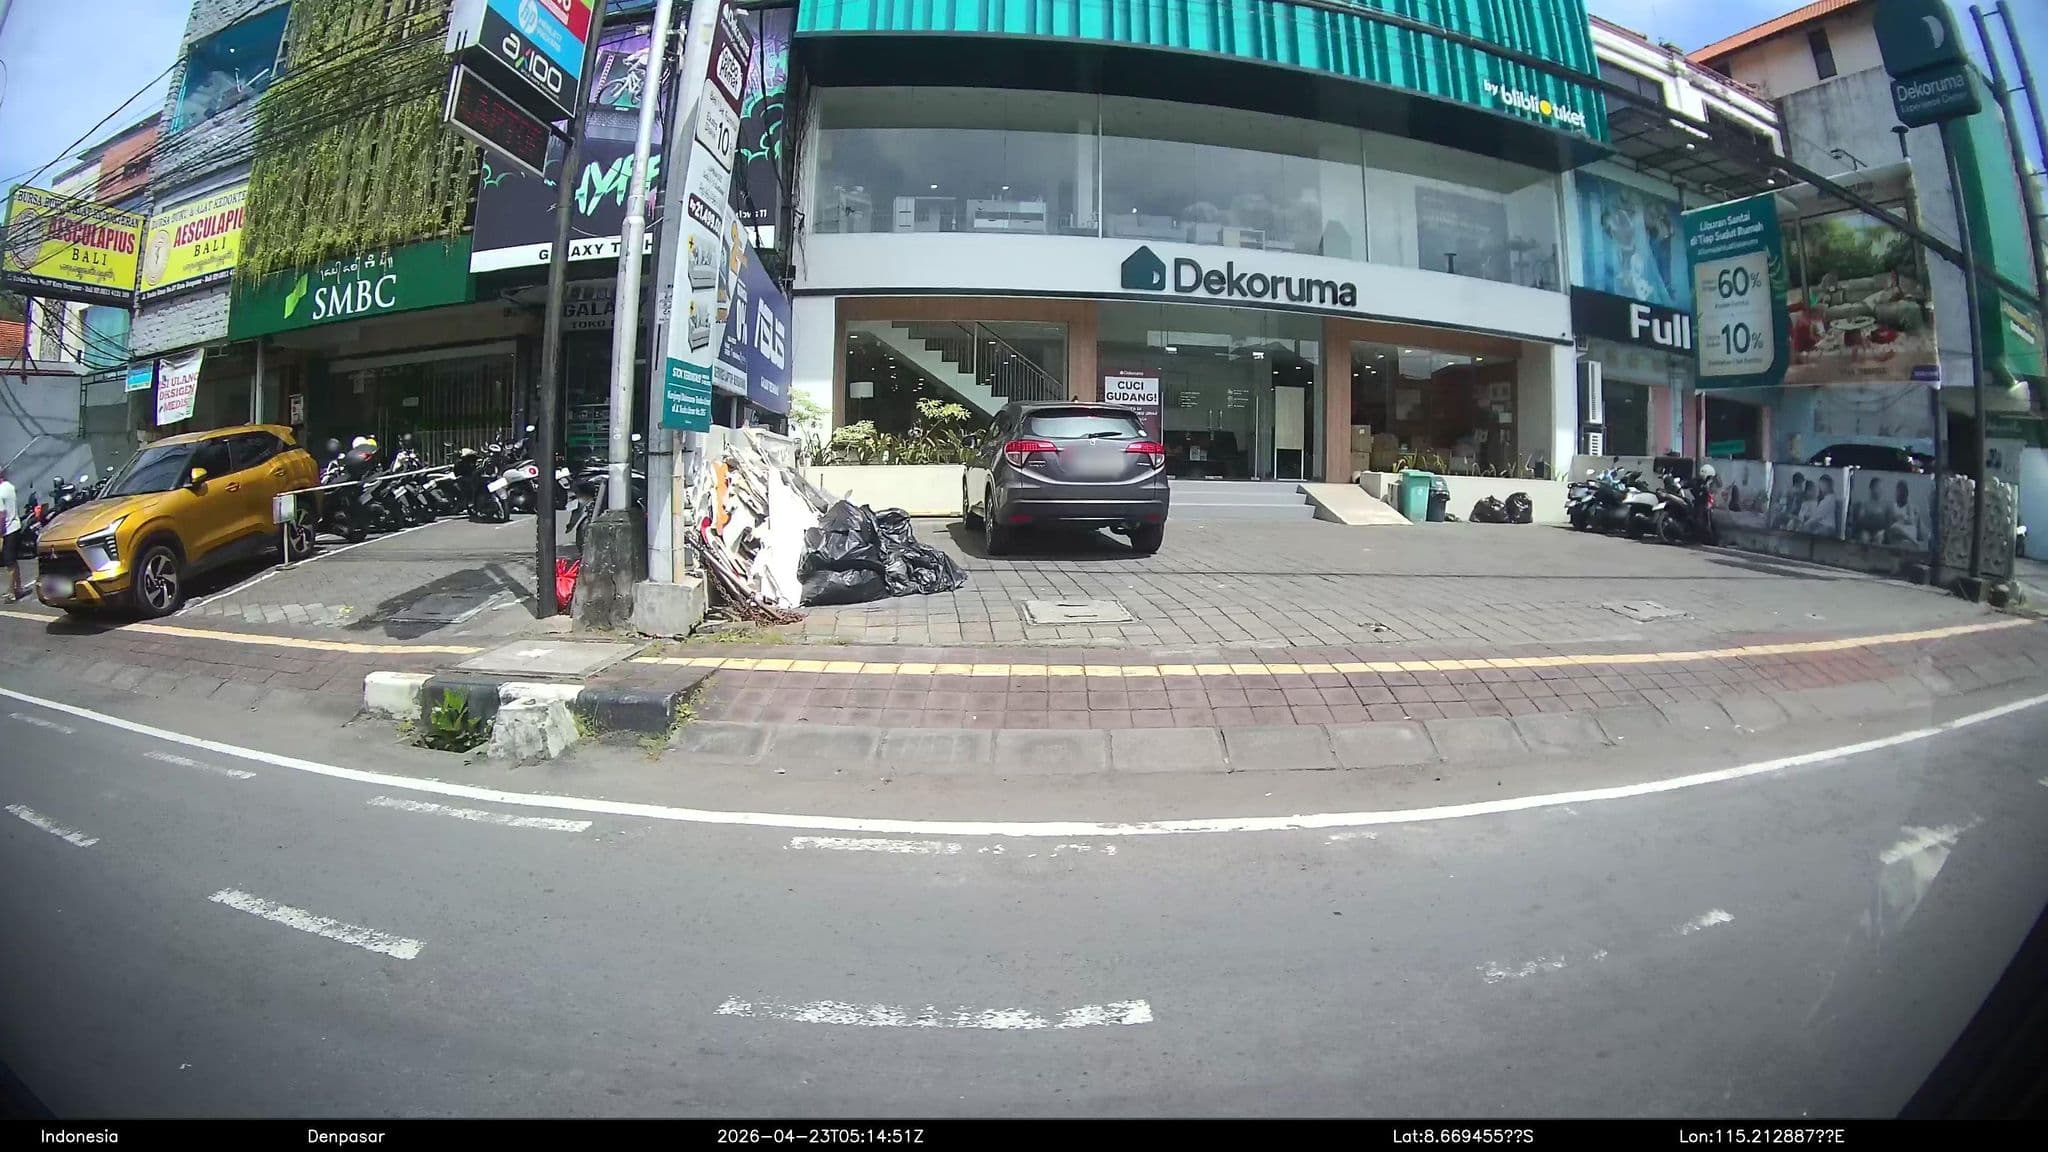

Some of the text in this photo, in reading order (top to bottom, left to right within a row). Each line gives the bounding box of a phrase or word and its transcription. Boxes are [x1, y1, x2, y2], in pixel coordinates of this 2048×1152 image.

[1483, 79, 1498, 96] by
[1896, 74, 1965, 101] Dekoruma
[48, 216, 136, 255] AESCULAPIUS
[194, 237, 226, 257] BALI
[72, 248, 107, 265] BALI
[1174, 257, 1357, 307] Dekoruma
[313, 275, 397, 320] SMBC
[1630, 303, 1691, 349] Full
[1106, 391, 1158, 402] GUDANG!
[1117, 381, 1144, 391] CUCI
